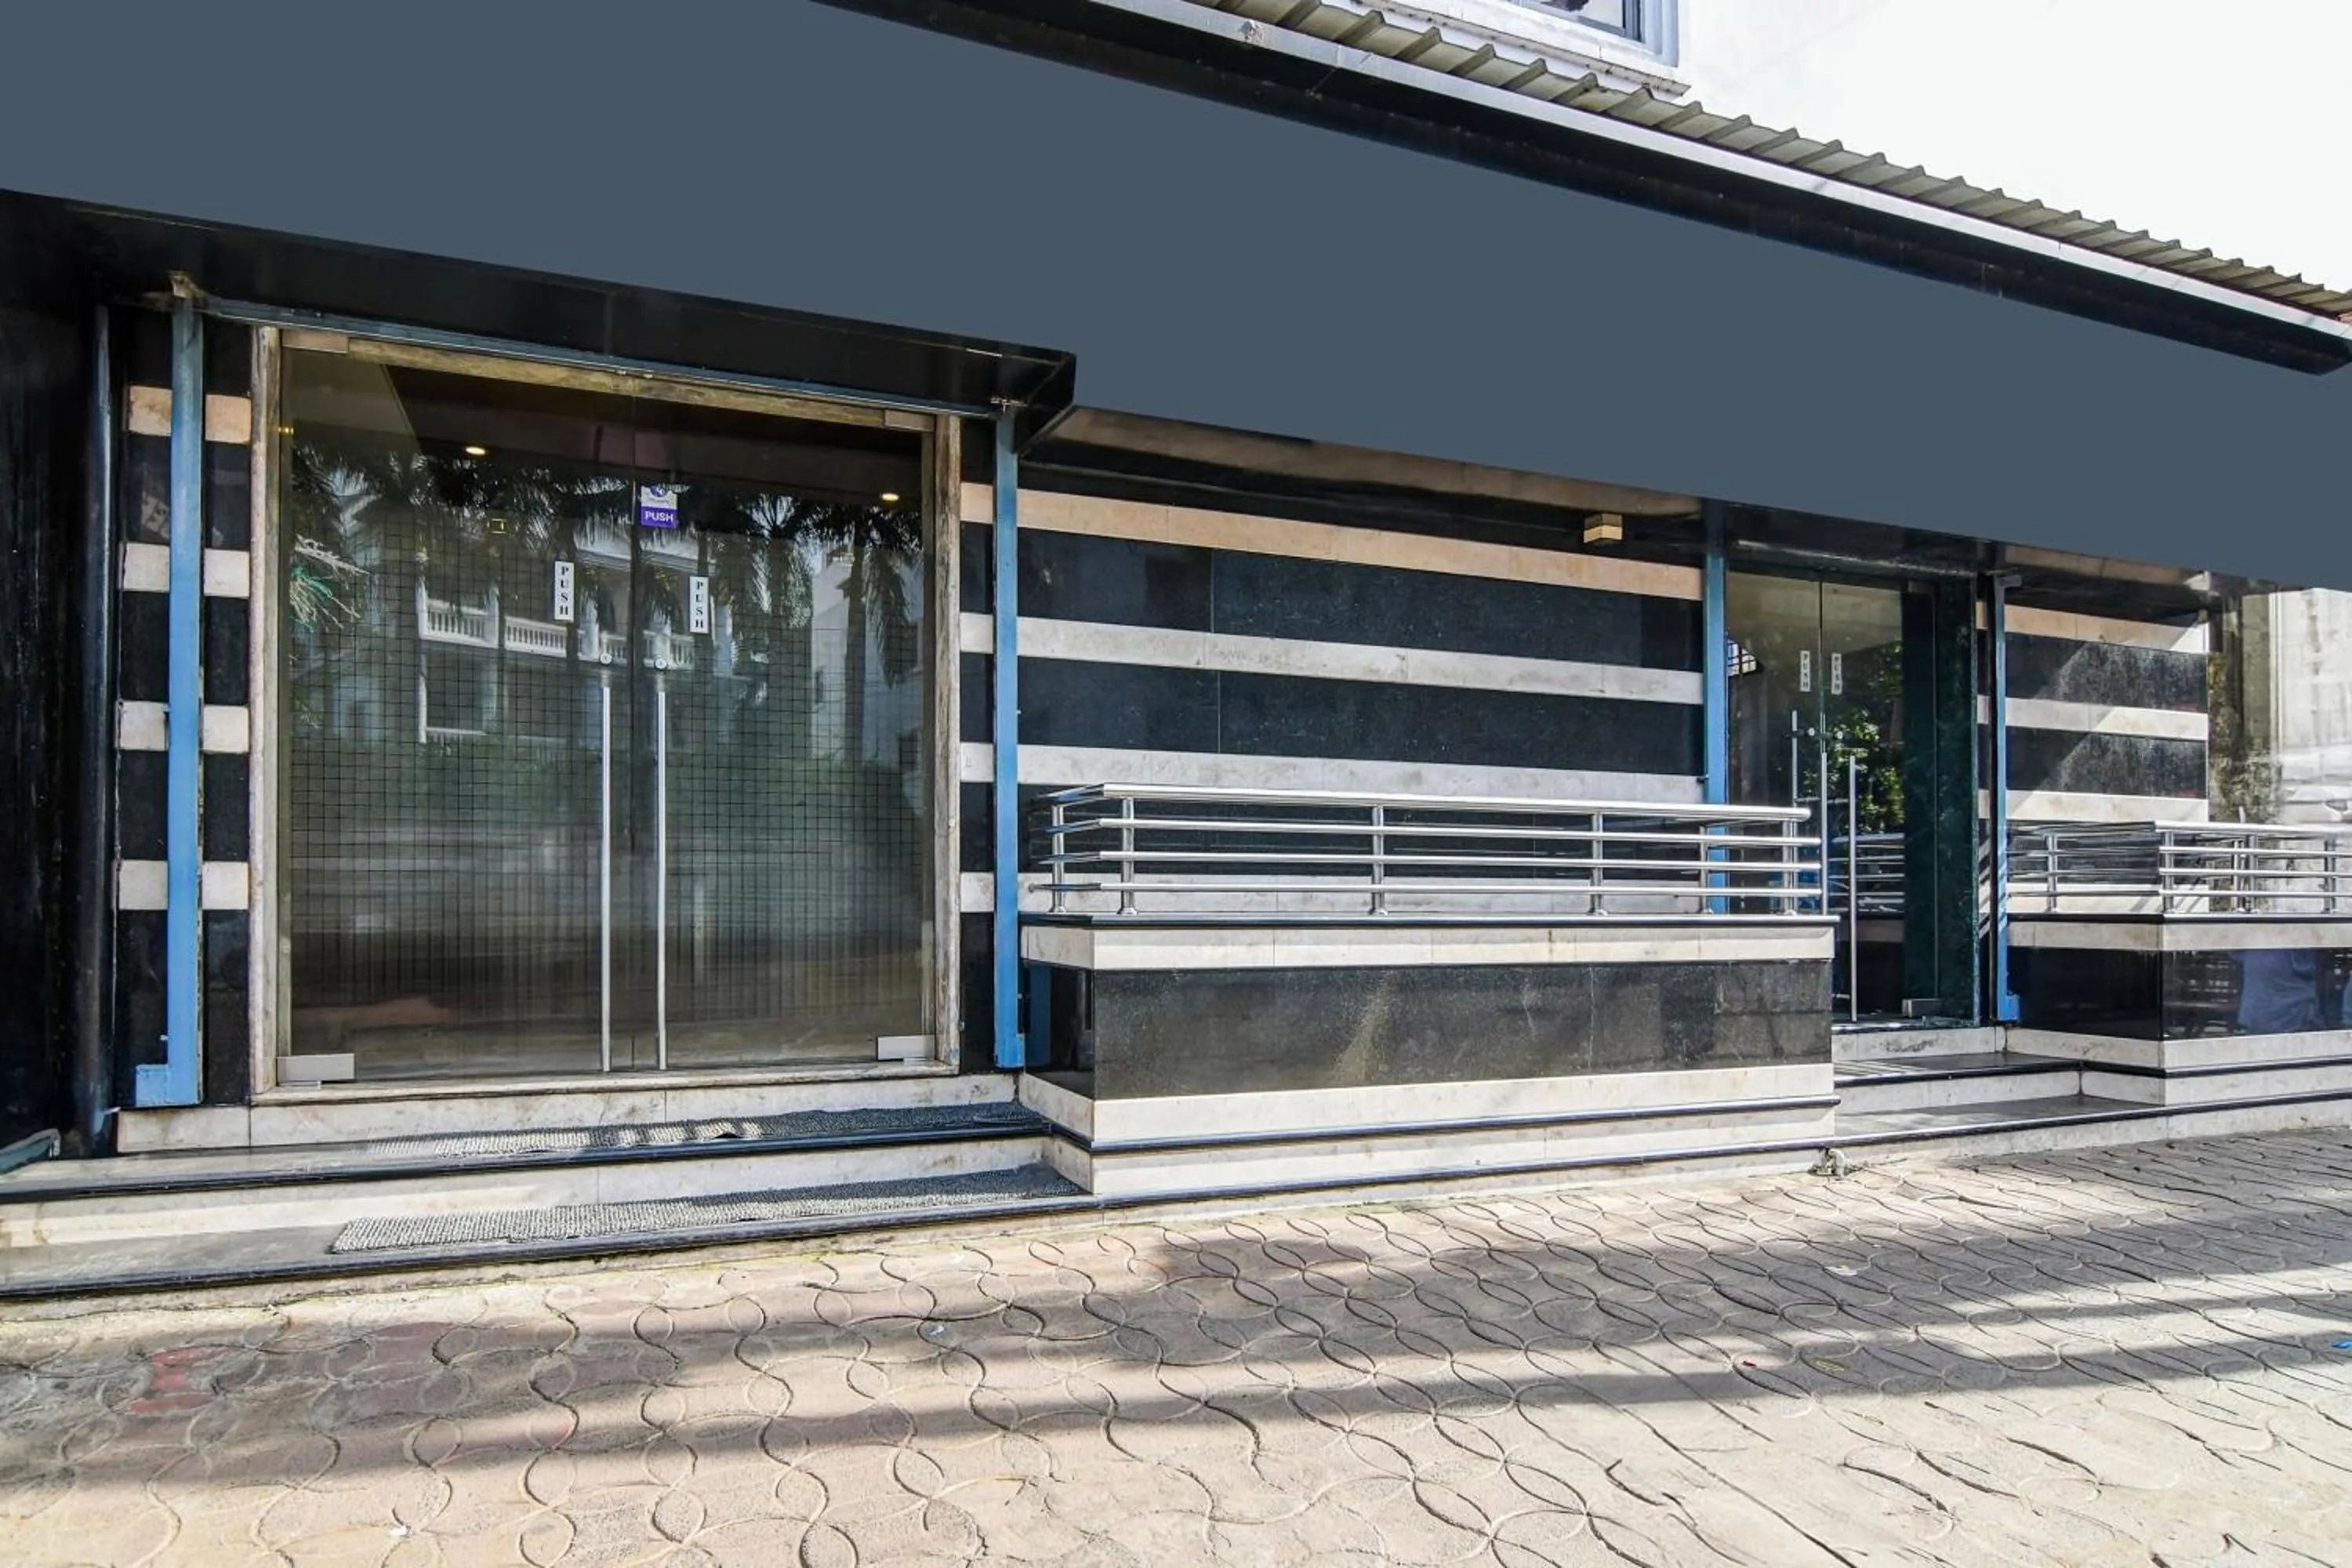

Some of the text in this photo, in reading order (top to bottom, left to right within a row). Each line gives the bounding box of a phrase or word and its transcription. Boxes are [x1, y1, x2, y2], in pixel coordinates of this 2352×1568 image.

[644, 510, 673, 523] PUSH
[559, 565, 570, 616] PUSH
[694, 580, 704, 629] PUSH
